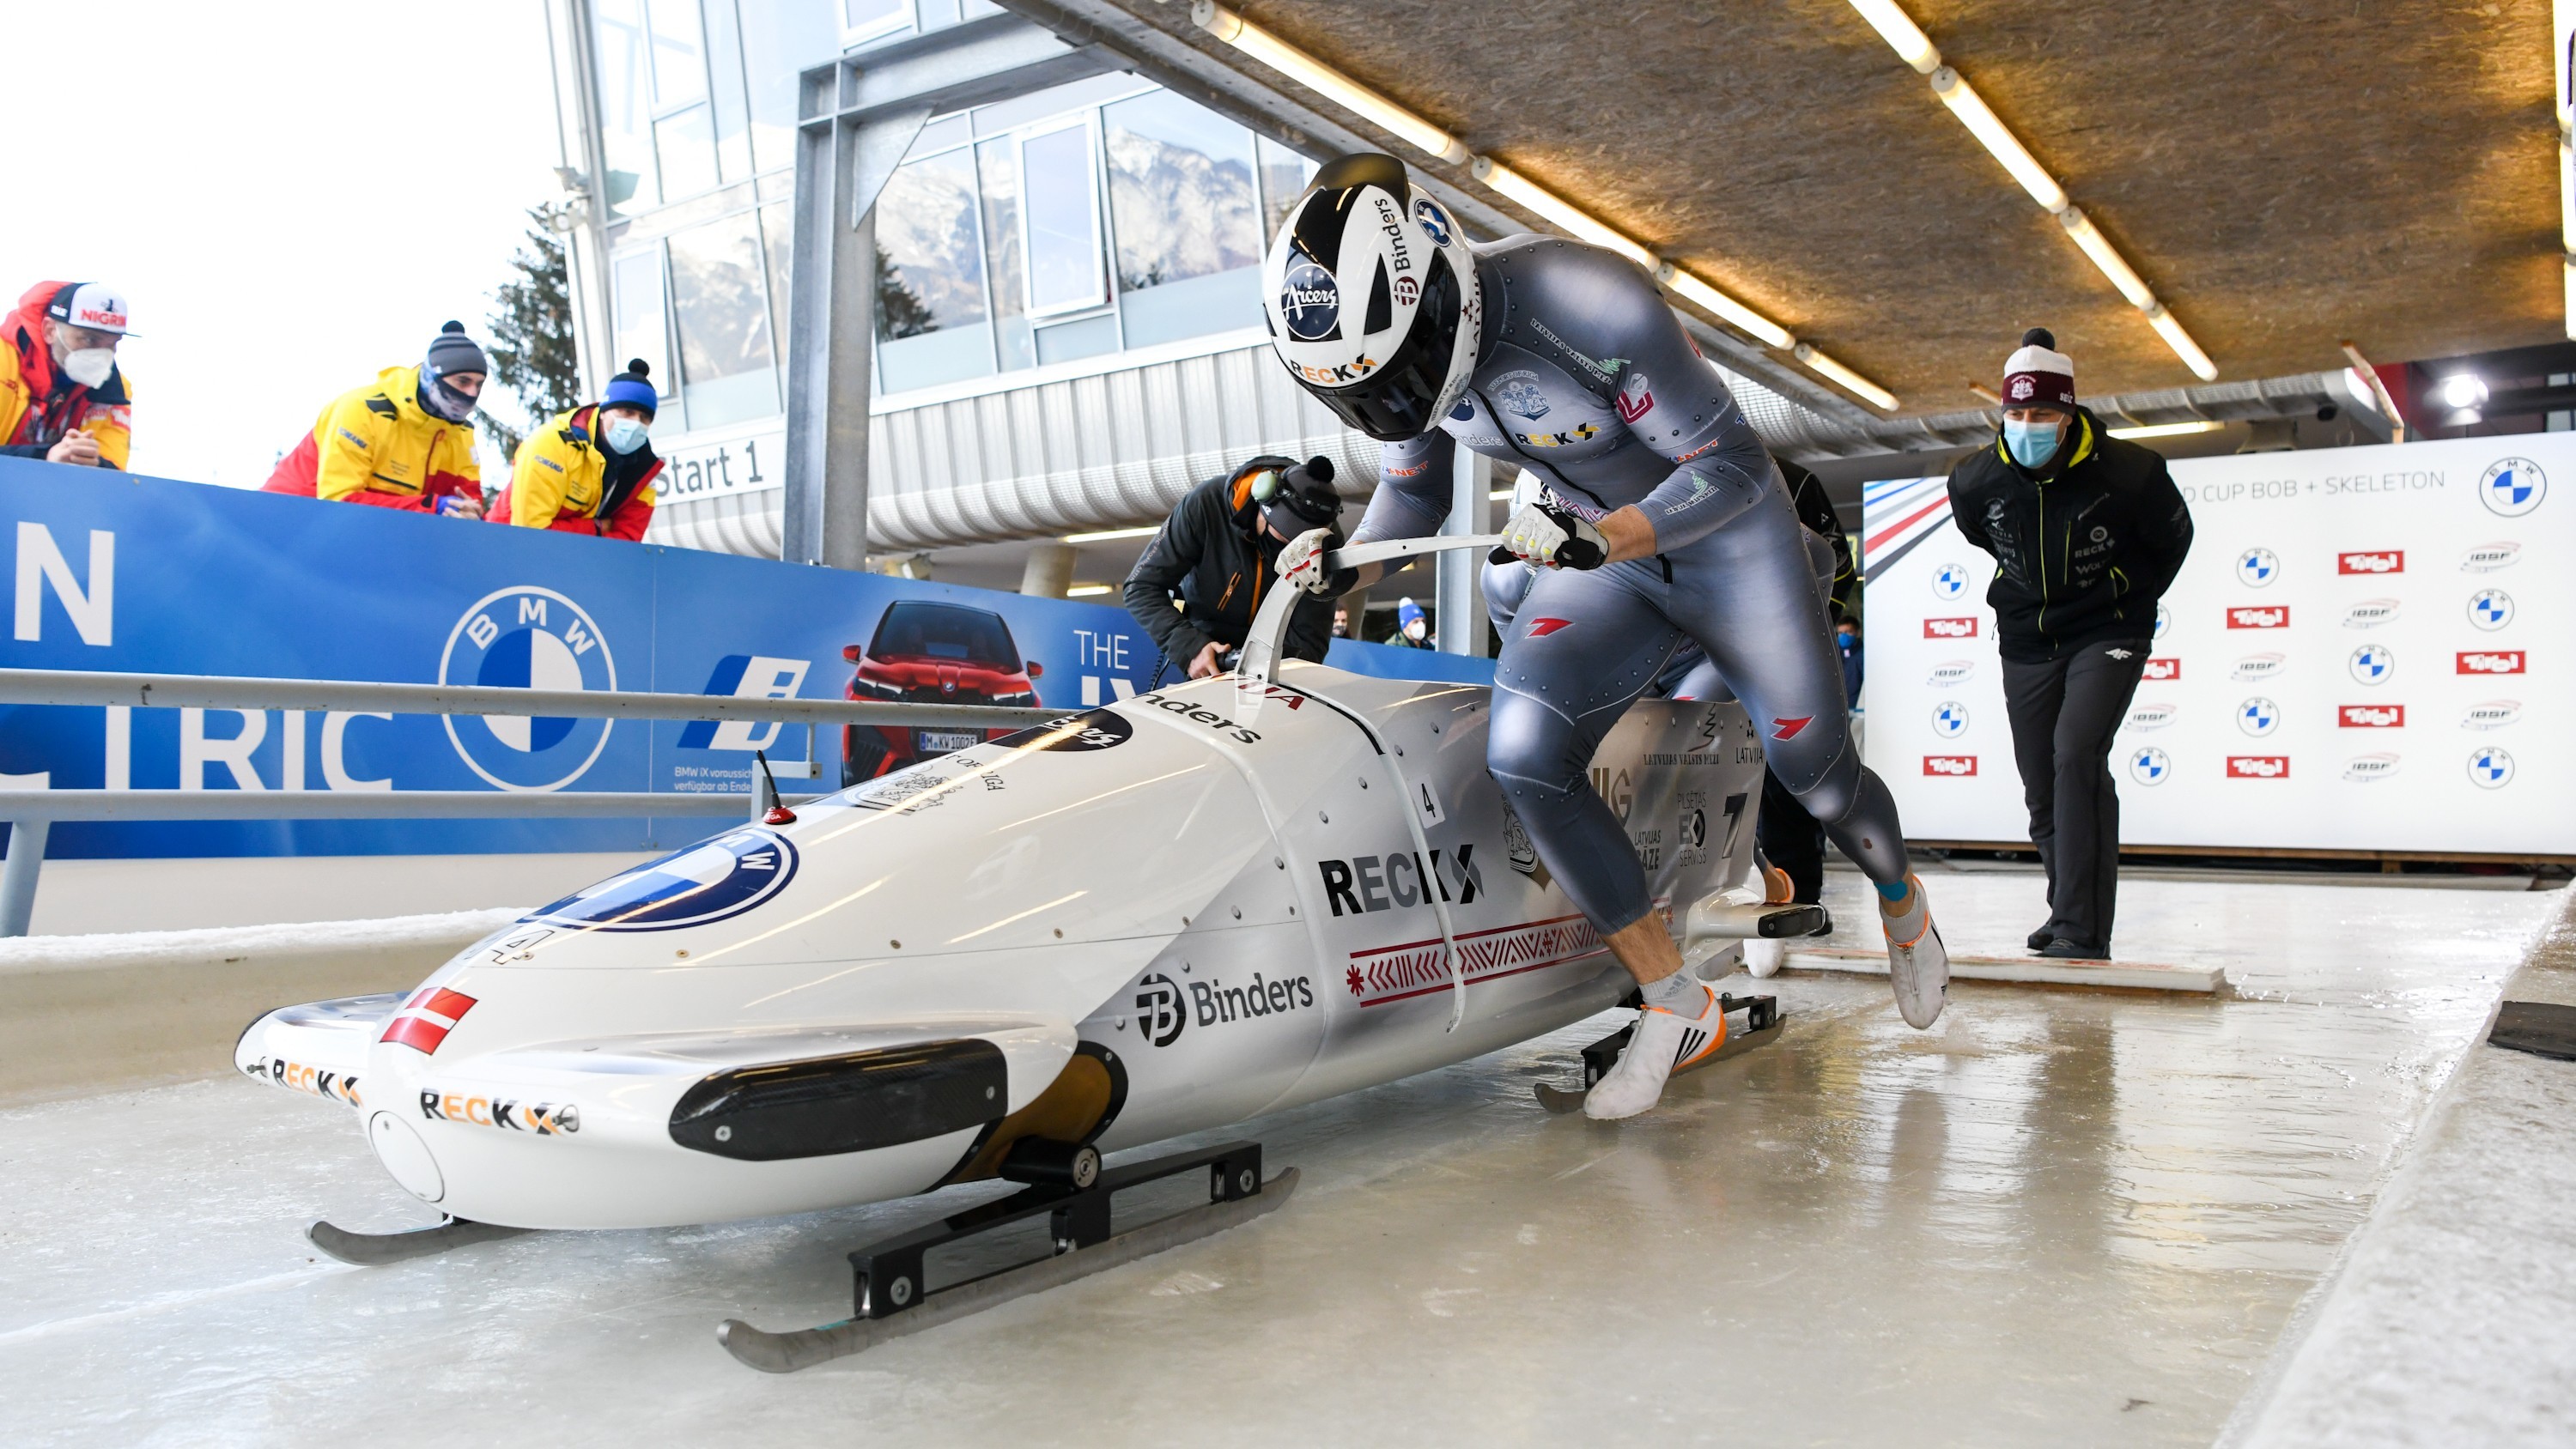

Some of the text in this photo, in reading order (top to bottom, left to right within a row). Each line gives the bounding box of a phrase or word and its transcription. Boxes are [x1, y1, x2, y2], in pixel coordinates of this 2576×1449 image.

[1375, 198, 1412, 273] Binders
[745, 440, 763, 482] 1
[2203, 483, 2245, 503] CUP
[2252, 479, 2298, 500] BOB
[2325, 470, 2445, 495] SKELETON
[466, 597, 597, 657] BMW
[1073, 630, 1130, 670] THE
[1132, 694, 1261, 744] nders
[674, 767, 698, 777] BMW
[674, 779, 751, 793] verfügbar ab Ende
[981, 769, 1006, 791] IGA
[1420, 782, 1437, 818] 4
[1188, 973, 1314, 1028] Binders
